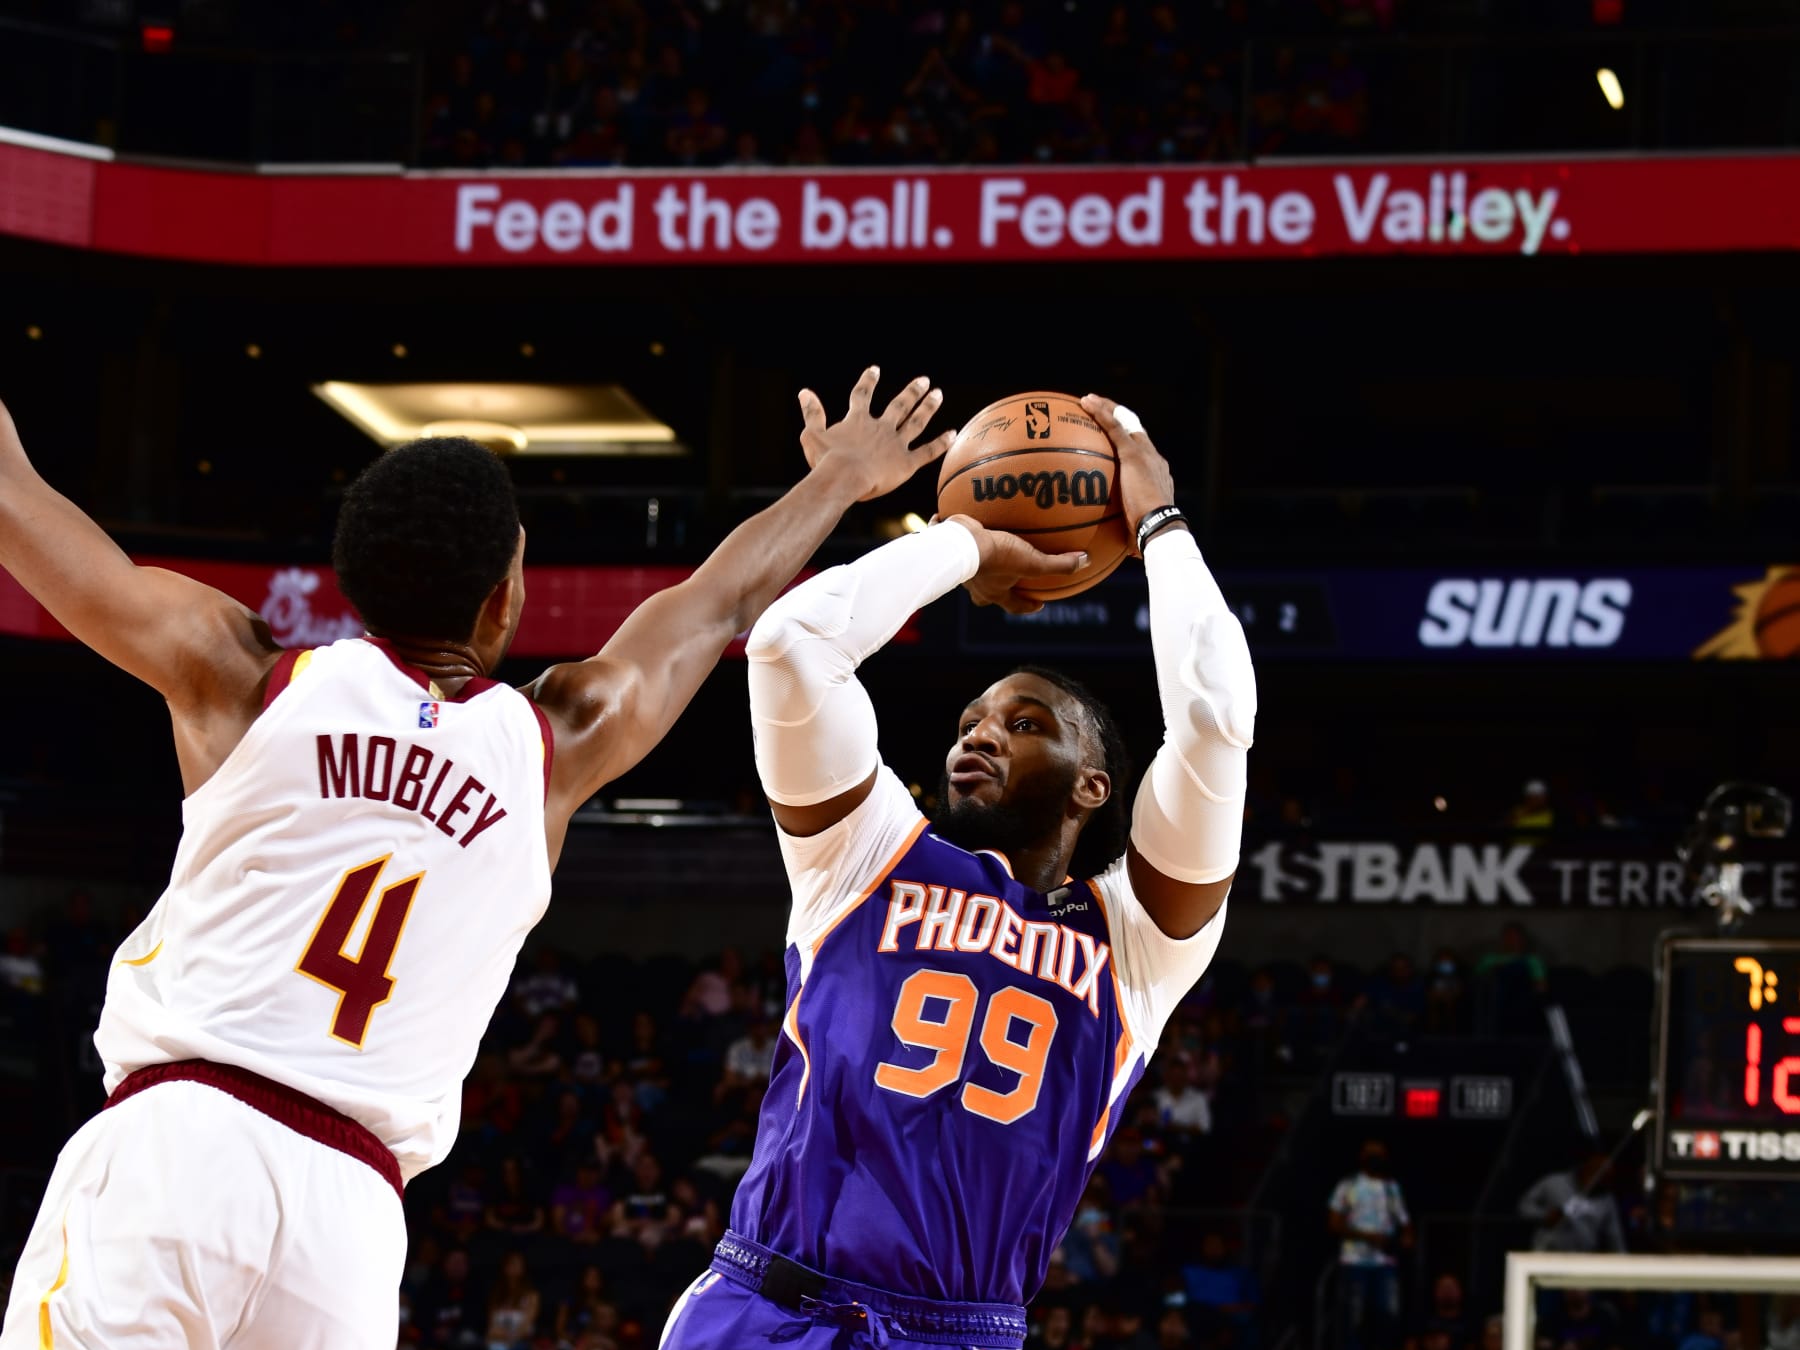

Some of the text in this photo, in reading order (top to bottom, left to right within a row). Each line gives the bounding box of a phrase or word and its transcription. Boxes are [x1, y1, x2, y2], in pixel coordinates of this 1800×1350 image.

[454, 172, 1571, 256] Feed the ball. Feed the Valley.
[972, 468, 1109, 509] Wilson
[1418, 579, 1632, 648] SUNS
[316, 733, 508, 849] MOBLEY
[877, 879, 1110, 1019] PHOENIX
[1049, 901, 1089, 917] ayPal
[293, 852, 427, 1052] 4
[874, 968, 1059, 1125] 99
[1721, 1131, 1800, 1161] TISS
